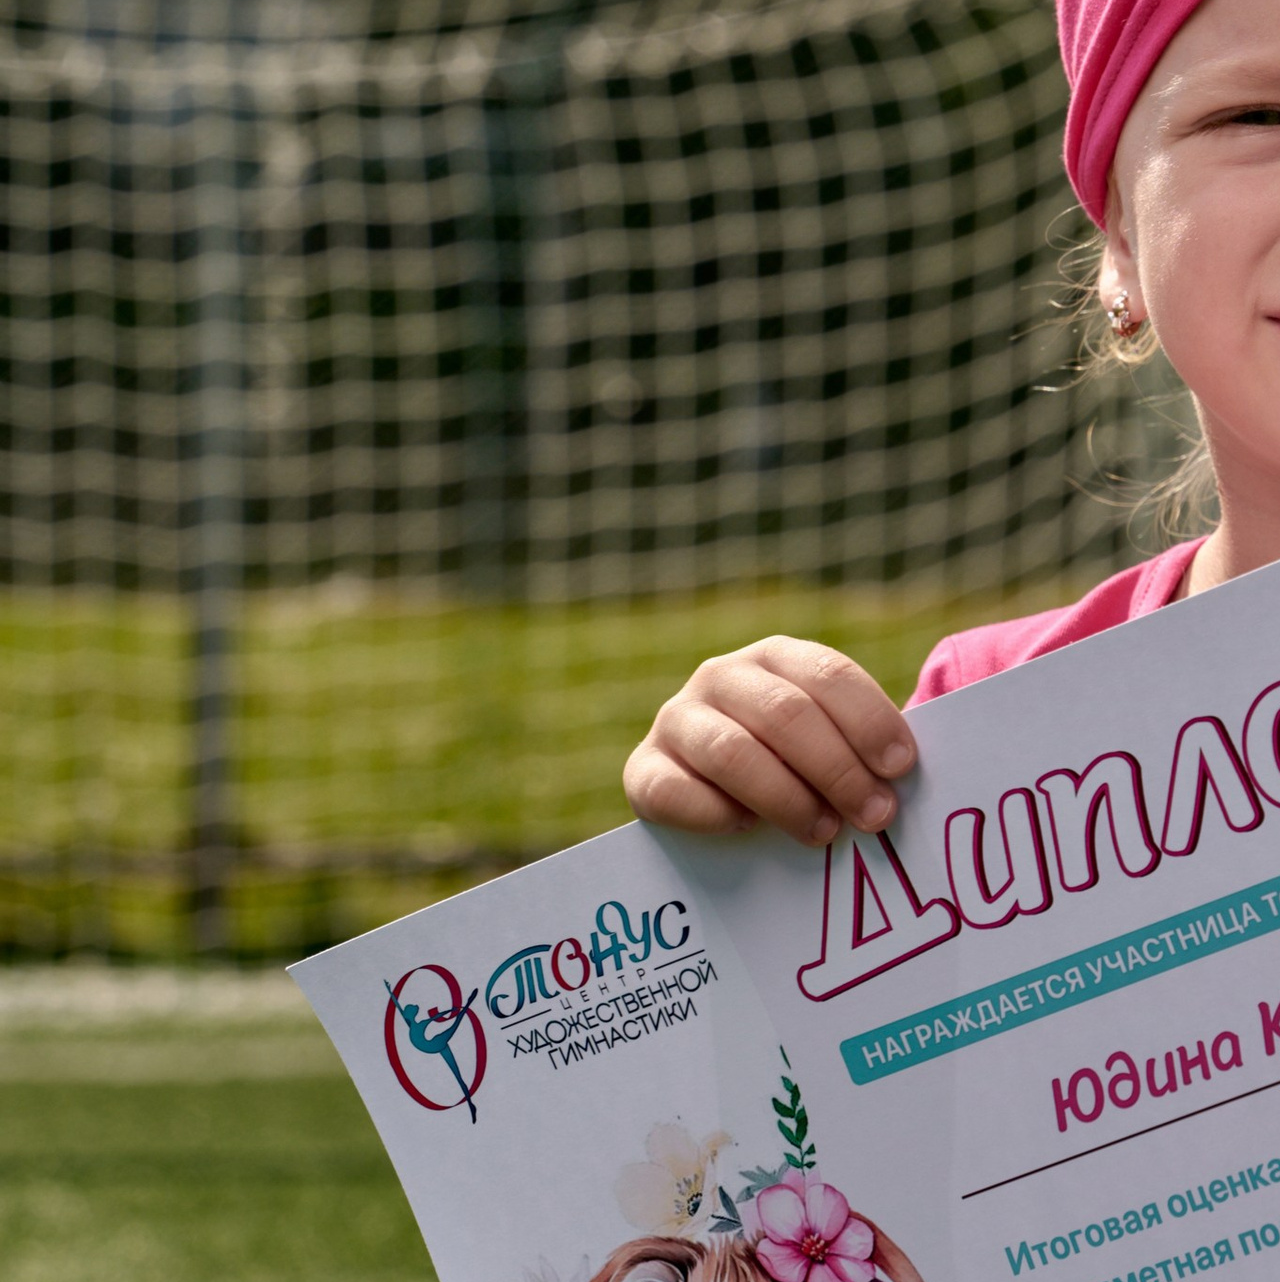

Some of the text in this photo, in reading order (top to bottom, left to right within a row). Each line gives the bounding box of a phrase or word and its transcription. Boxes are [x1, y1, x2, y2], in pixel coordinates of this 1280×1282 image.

[506, 958, 719, 1058] ХУДОЖЕСТВЕННОЙ
[559, 967, 647, 1011] ЦЕНТР
[860, 966, 1087, 1071] НАГРАЖДАЕТСЯ
[1085, 902, 1262, 987] УЧАСТНИЦА
[547, 998, 698, 1070] ГИМНАСТИКИ
[1051, 1028, 1244, 1132] Юдина
[1004, 1199, 1163, 1276] Итоговая
